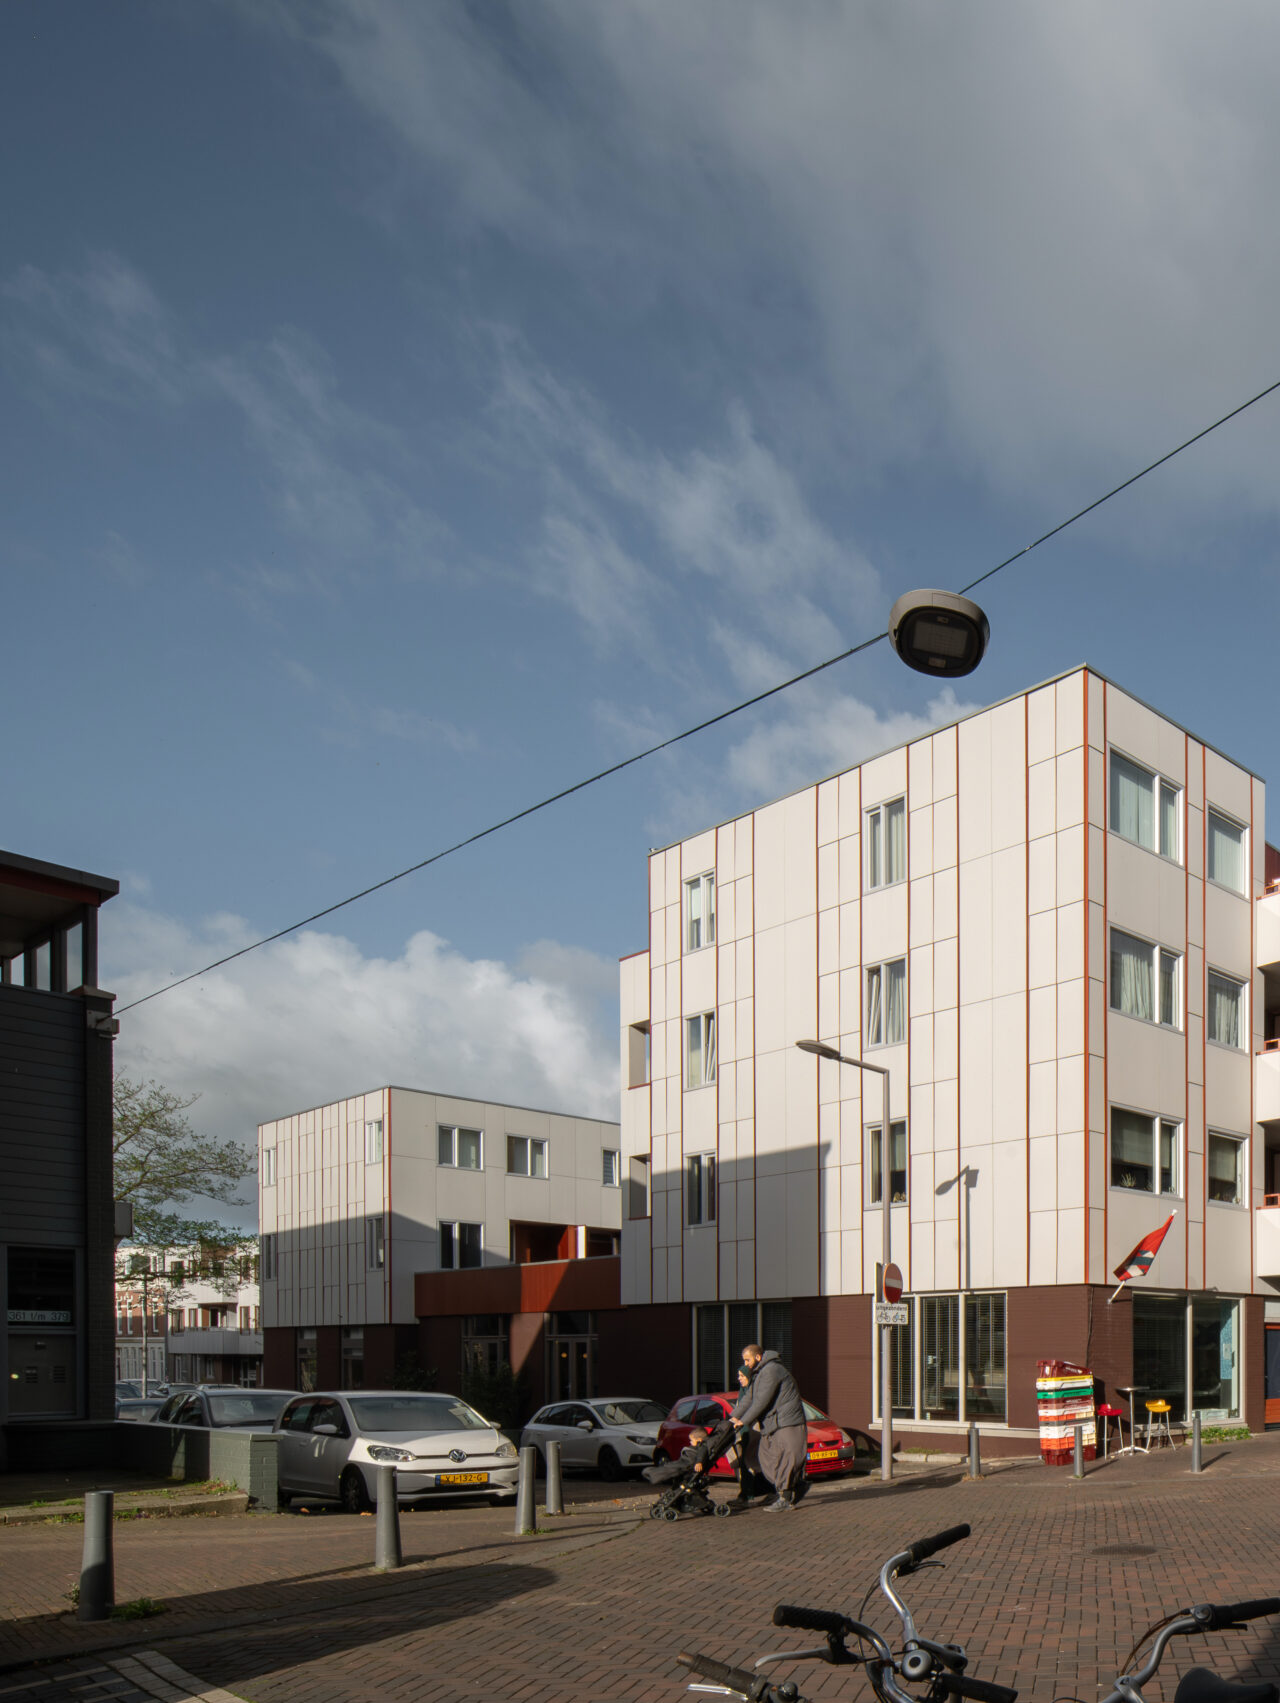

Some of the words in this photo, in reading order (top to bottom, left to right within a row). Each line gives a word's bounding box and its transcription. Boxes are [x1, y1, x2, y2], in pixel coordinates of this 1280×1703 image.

[8, 1311, 26, 1321] 361
[31, 1311, 46, 1321] t/m
[51, 1311, 69, 1321] 379
